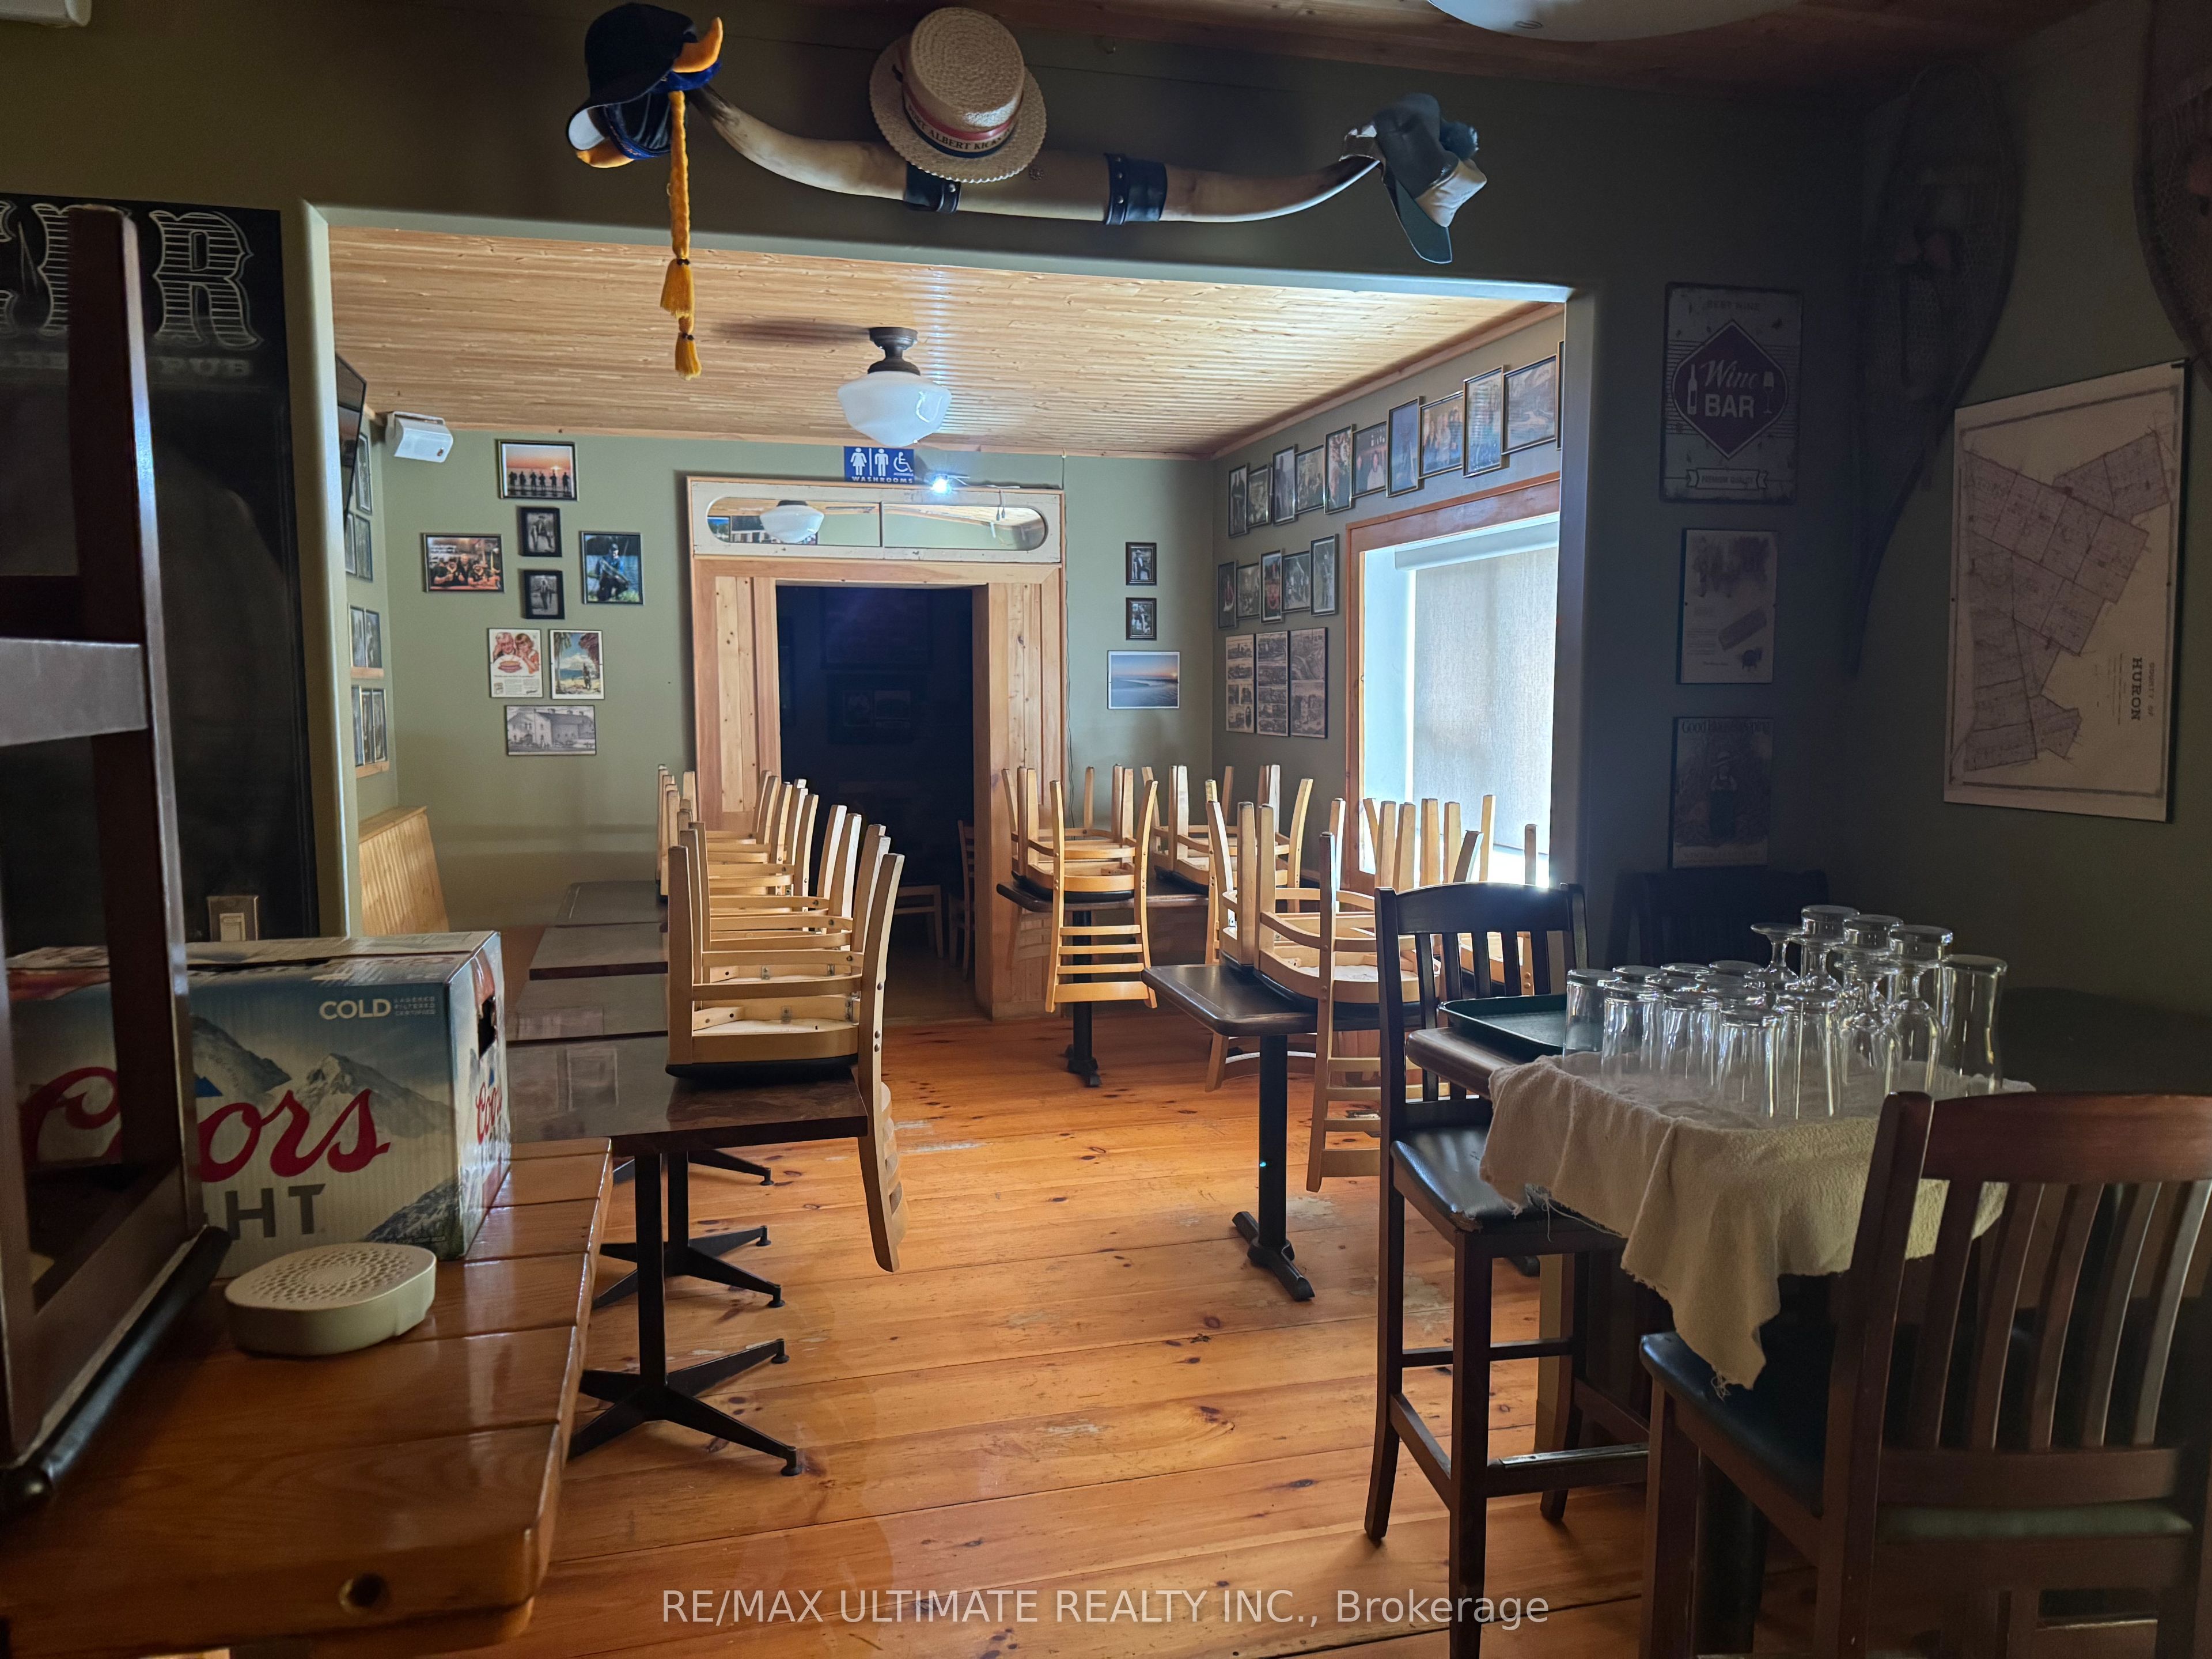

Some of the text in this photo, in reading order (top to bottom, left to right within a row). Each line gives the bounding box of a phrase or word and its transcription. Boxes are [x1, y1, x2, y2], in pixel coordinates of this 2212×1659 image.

[929, 130, 970, 150] ALBERT
[1699, 359, 1759, 389] Wine
[1705, 393, 1755, 419] BAR
[851, 476, 913, 484] WASHROOMS
[2131, 657, 2142, 720] HURON
[319, 998, 392, 1020] COLD
